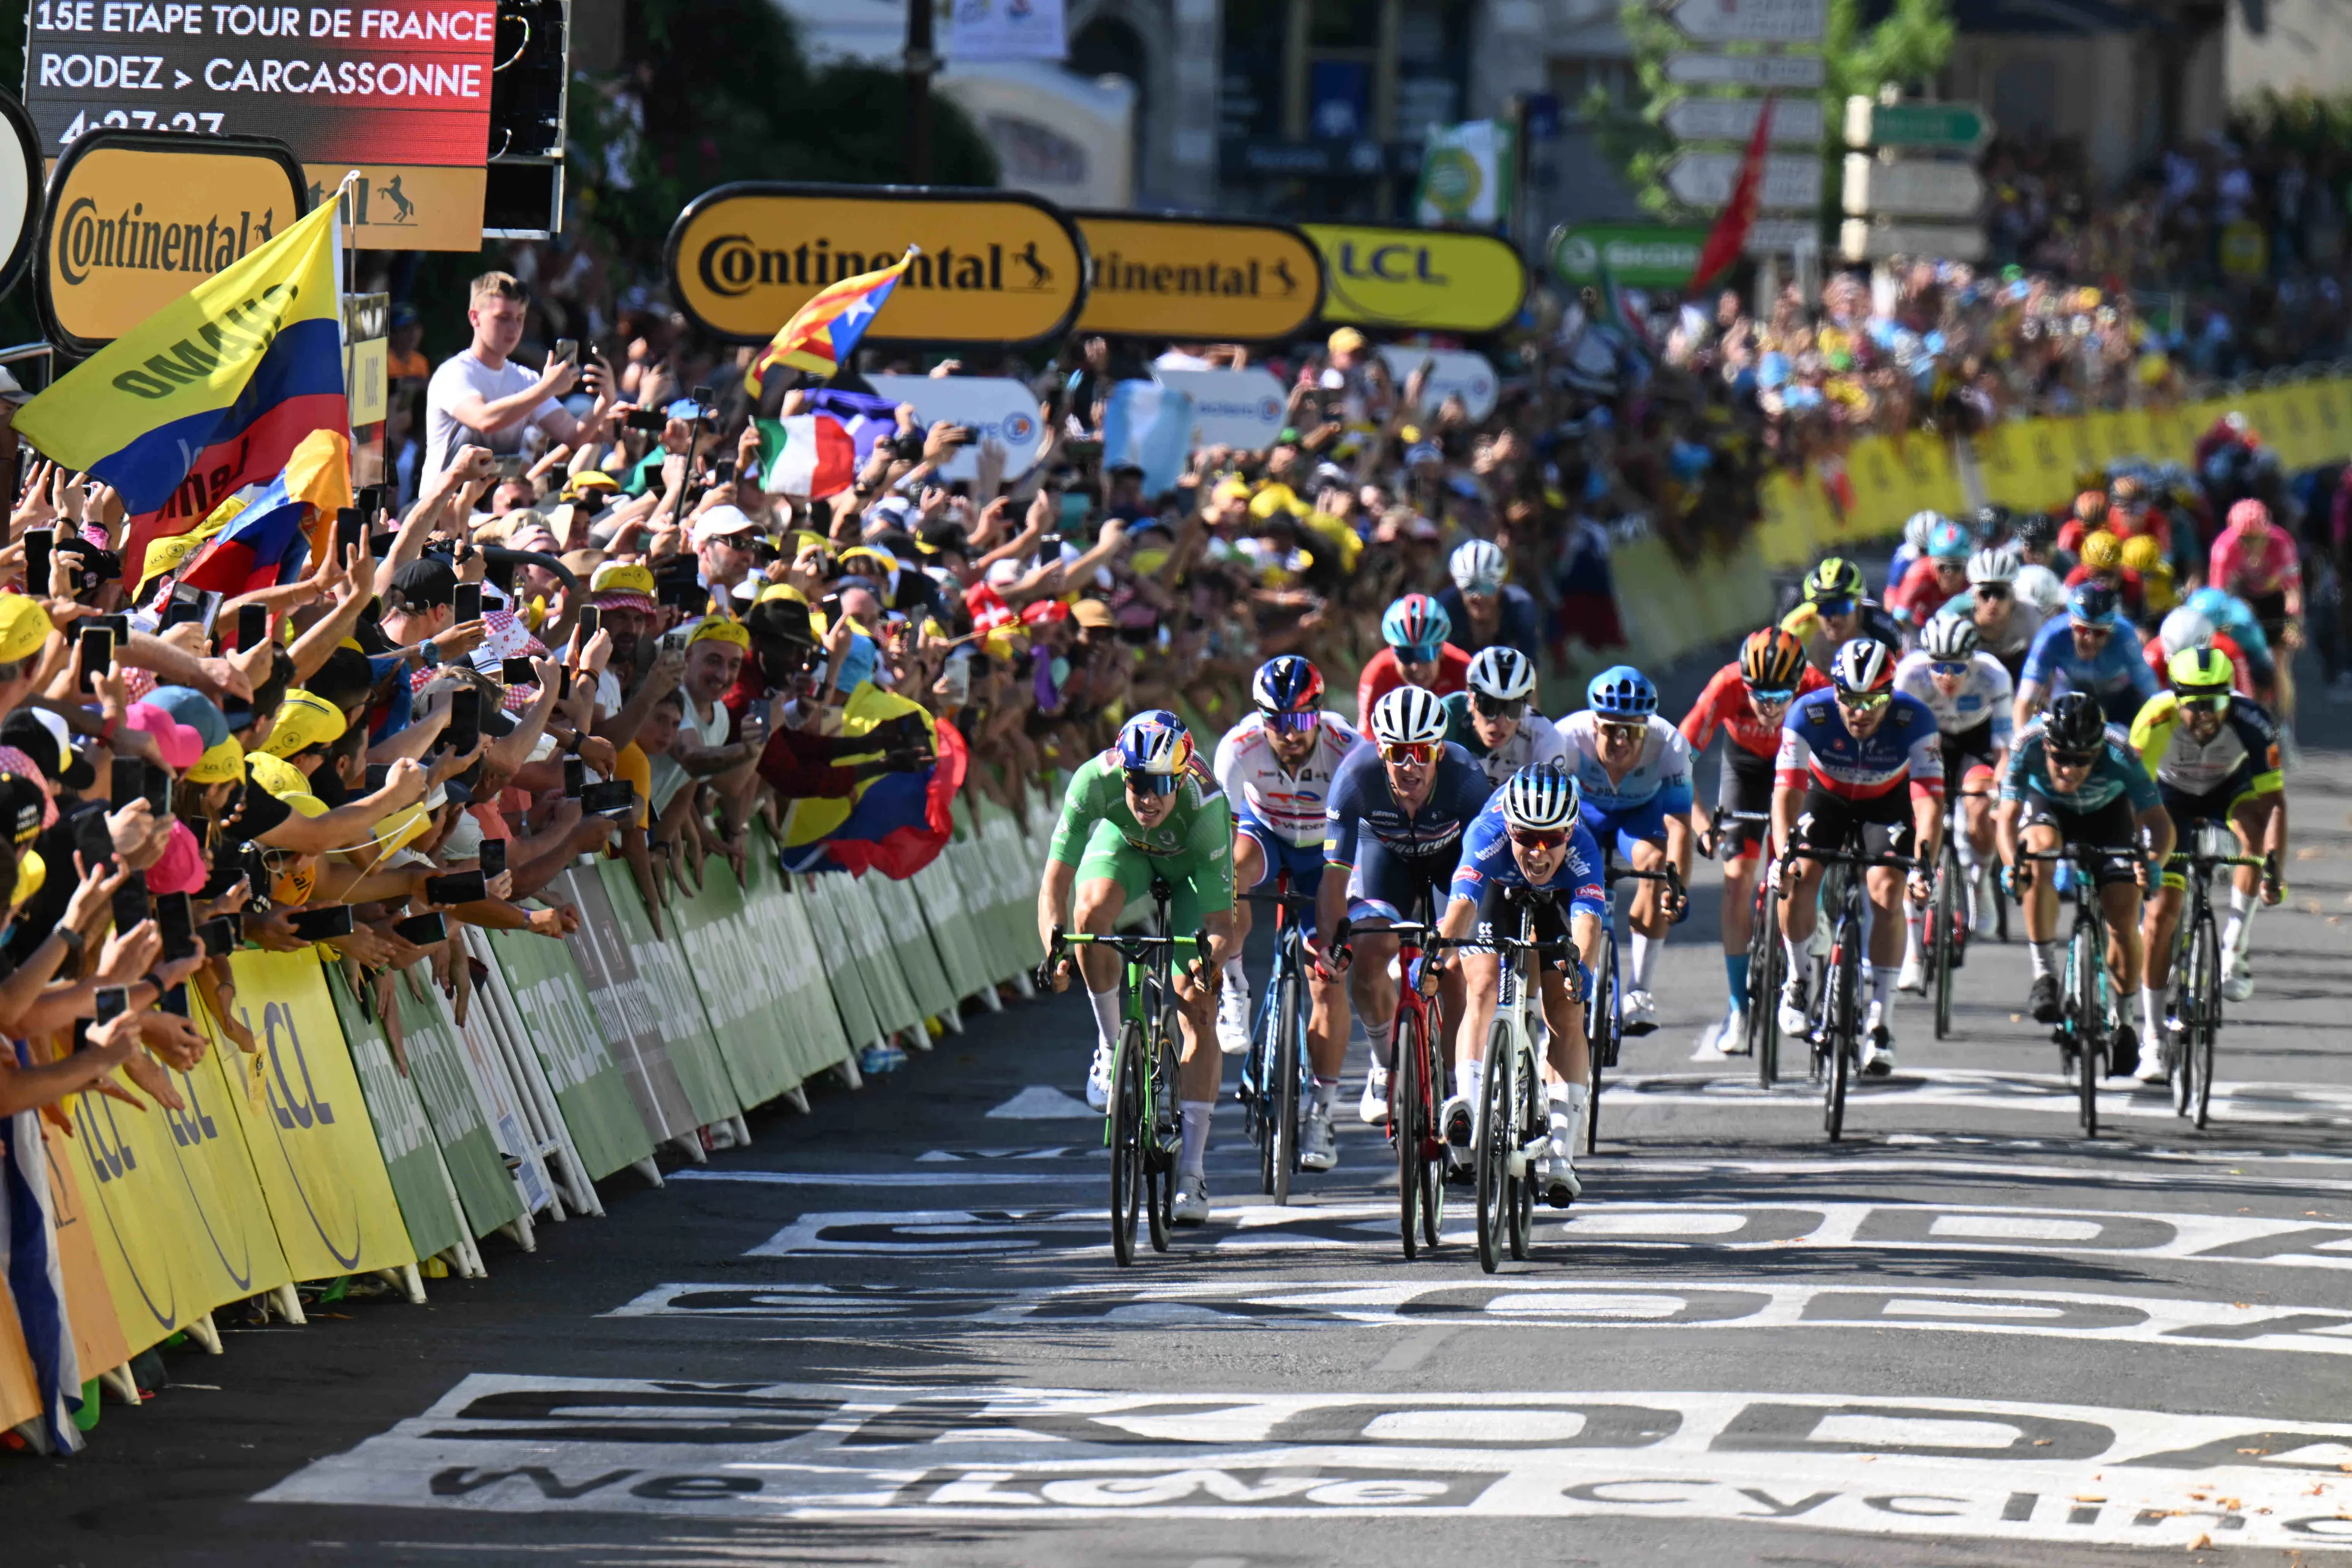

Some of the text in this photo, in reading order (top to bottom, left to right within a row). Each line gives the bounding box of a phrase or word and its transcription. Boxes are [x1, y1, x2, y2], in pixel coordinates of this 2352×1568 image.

[36, 1, 493, 41] 15E ETAPE TOUR DE FRANCE
[40, 53, 164, 89] RODEZ
[204, 58, 481, 97] CARCASSONNE
[58, 195, 251, 285] Continental
[1339, 239, 1448, 285] LCL
[699, 232, 1003, 296] Continental
[1092, 251, 1261, 295] tinental
[1163, 728, 1175, 756] LAZER
[240, 1001, 336, 1129] LCL
[927, 1468, 1449, 1507] Love
